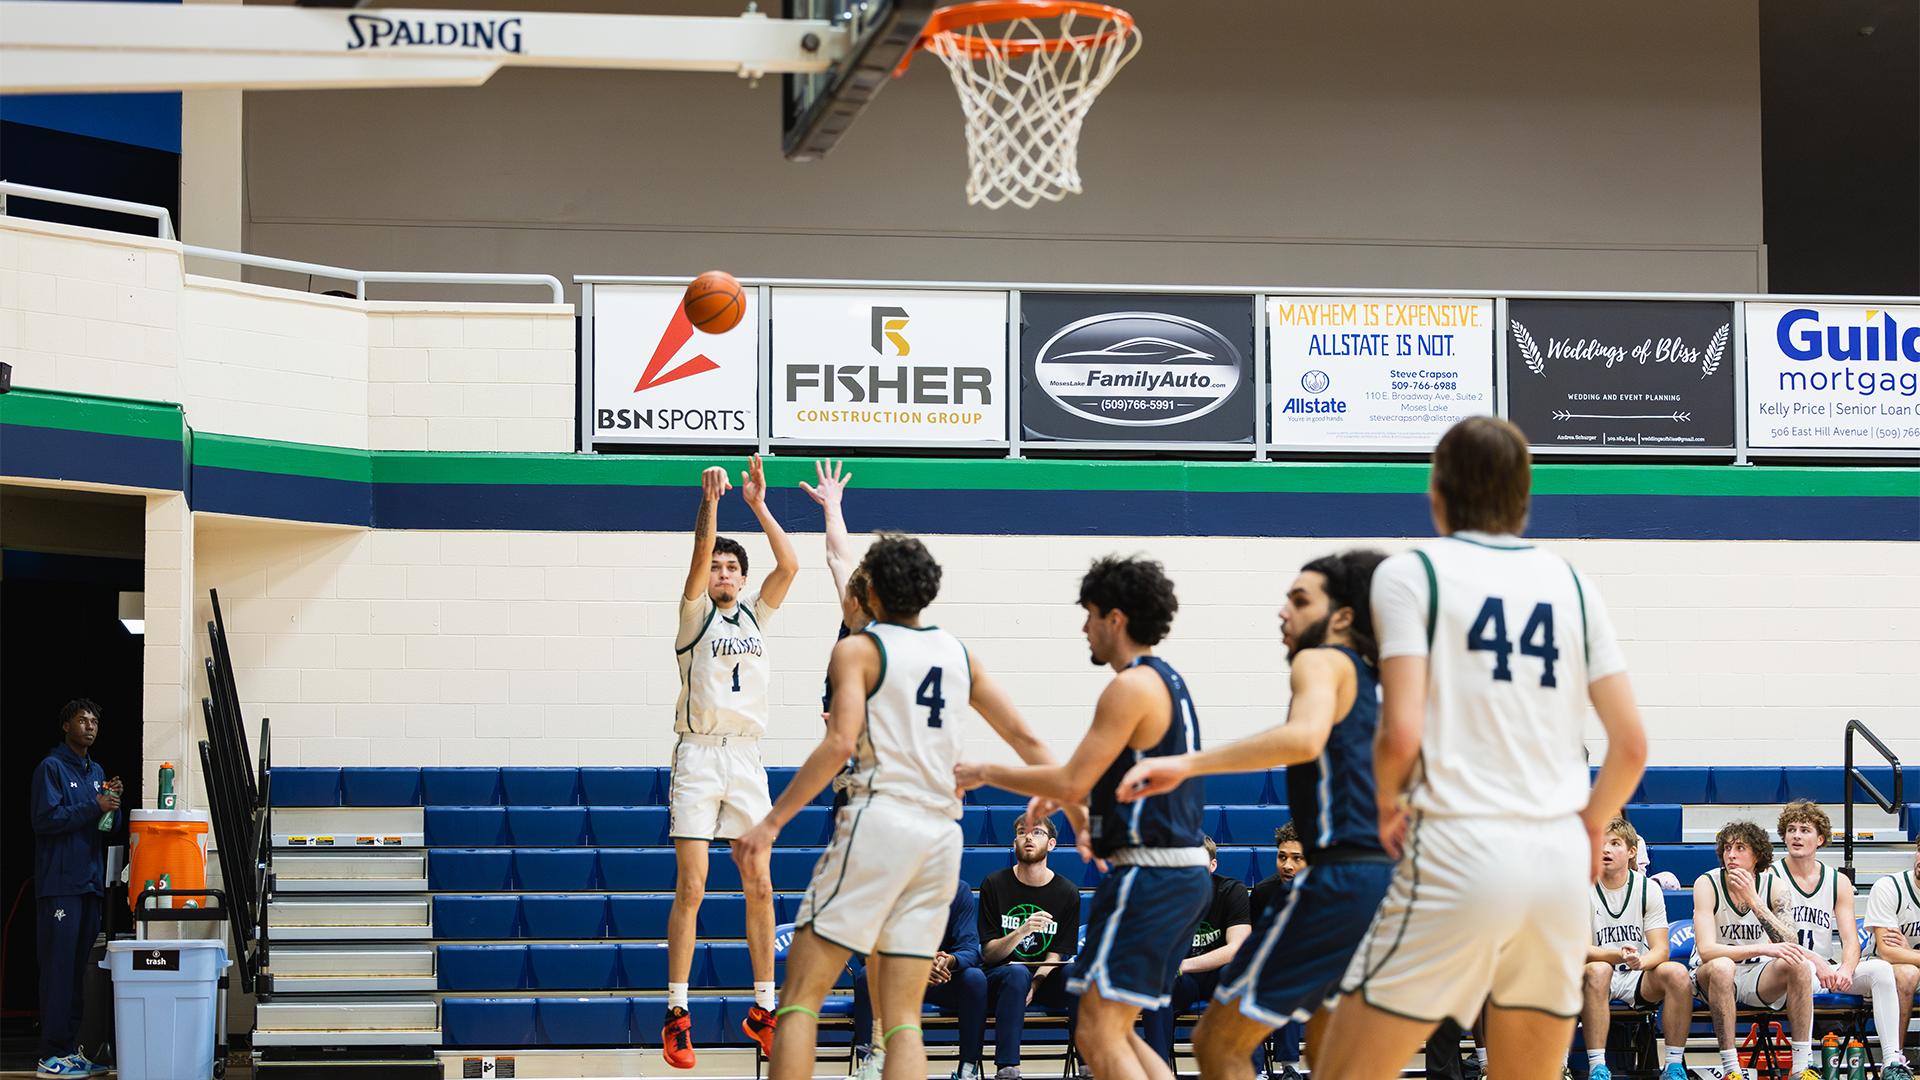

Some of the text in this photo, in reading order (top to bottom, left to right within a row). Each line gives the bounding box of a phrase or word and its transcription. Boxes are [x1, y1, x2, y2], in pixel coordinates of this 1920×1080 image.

[347, 14, 522, 54] SPALDING
[1279, 303, 1483, 327] MAYHEM IS EXPENSIVE.
[1308, 334, 1455, 356] ALLSTATE IS NOT.
[1547, 336, 1701, 368] Weddings of Bliss
[1390, 369, 1459, 381] Steve Crapson
[786, 364, 992, 405] FISHER
[1391, 381, 1457, 390] 509-766-6988
[1100, 399, 1175, 411] (509)766-5991
[1282, 398, 1347, 413] Allstate
[1391, 391, 1433, 402] Broadway
[1455, 392, 1477, 401] Suite
[1478, 393, 1484, 401] 2
[1567, 393, 1600, 401] WEDDING
[1602, 393, 1618, 401] AND
[1645, 394, 1681, 402] PLANNING
[1400, 403, 1448, 411] Moses Lake
[1759, 402, 1790, 418] Kelly
[1793, 402, 1826, 415] Price
[1835, 402, 1877, 415] Senior
[1880, 403, 1911, 416] Loan
[597, 408, 746, 431] BSN SPORTS
[796, 410, 983, 425] CONSTRUCTION GROUP
[1770, 426, 1790, 438] 506
[1792, 427, 1812, 437] East
[1814, 426, 1831, 437] Hill
[1832, 427, 1869, 437] Avenue
[1875, 427, 1901, 439] (509)
[711, 637, 762, 658] VIKINGS
[1467, 596, 1559, 688] 44
[731, 662, 741, 692] 1
[916, 665, 945, 728] 4
[1001, 914, 1020, 930] BIG
[1791, 905, 1831, 929] IKINGS
[1596, 925, 1643, 947] VIKINGS
[145, 957, 167, 966] trash
